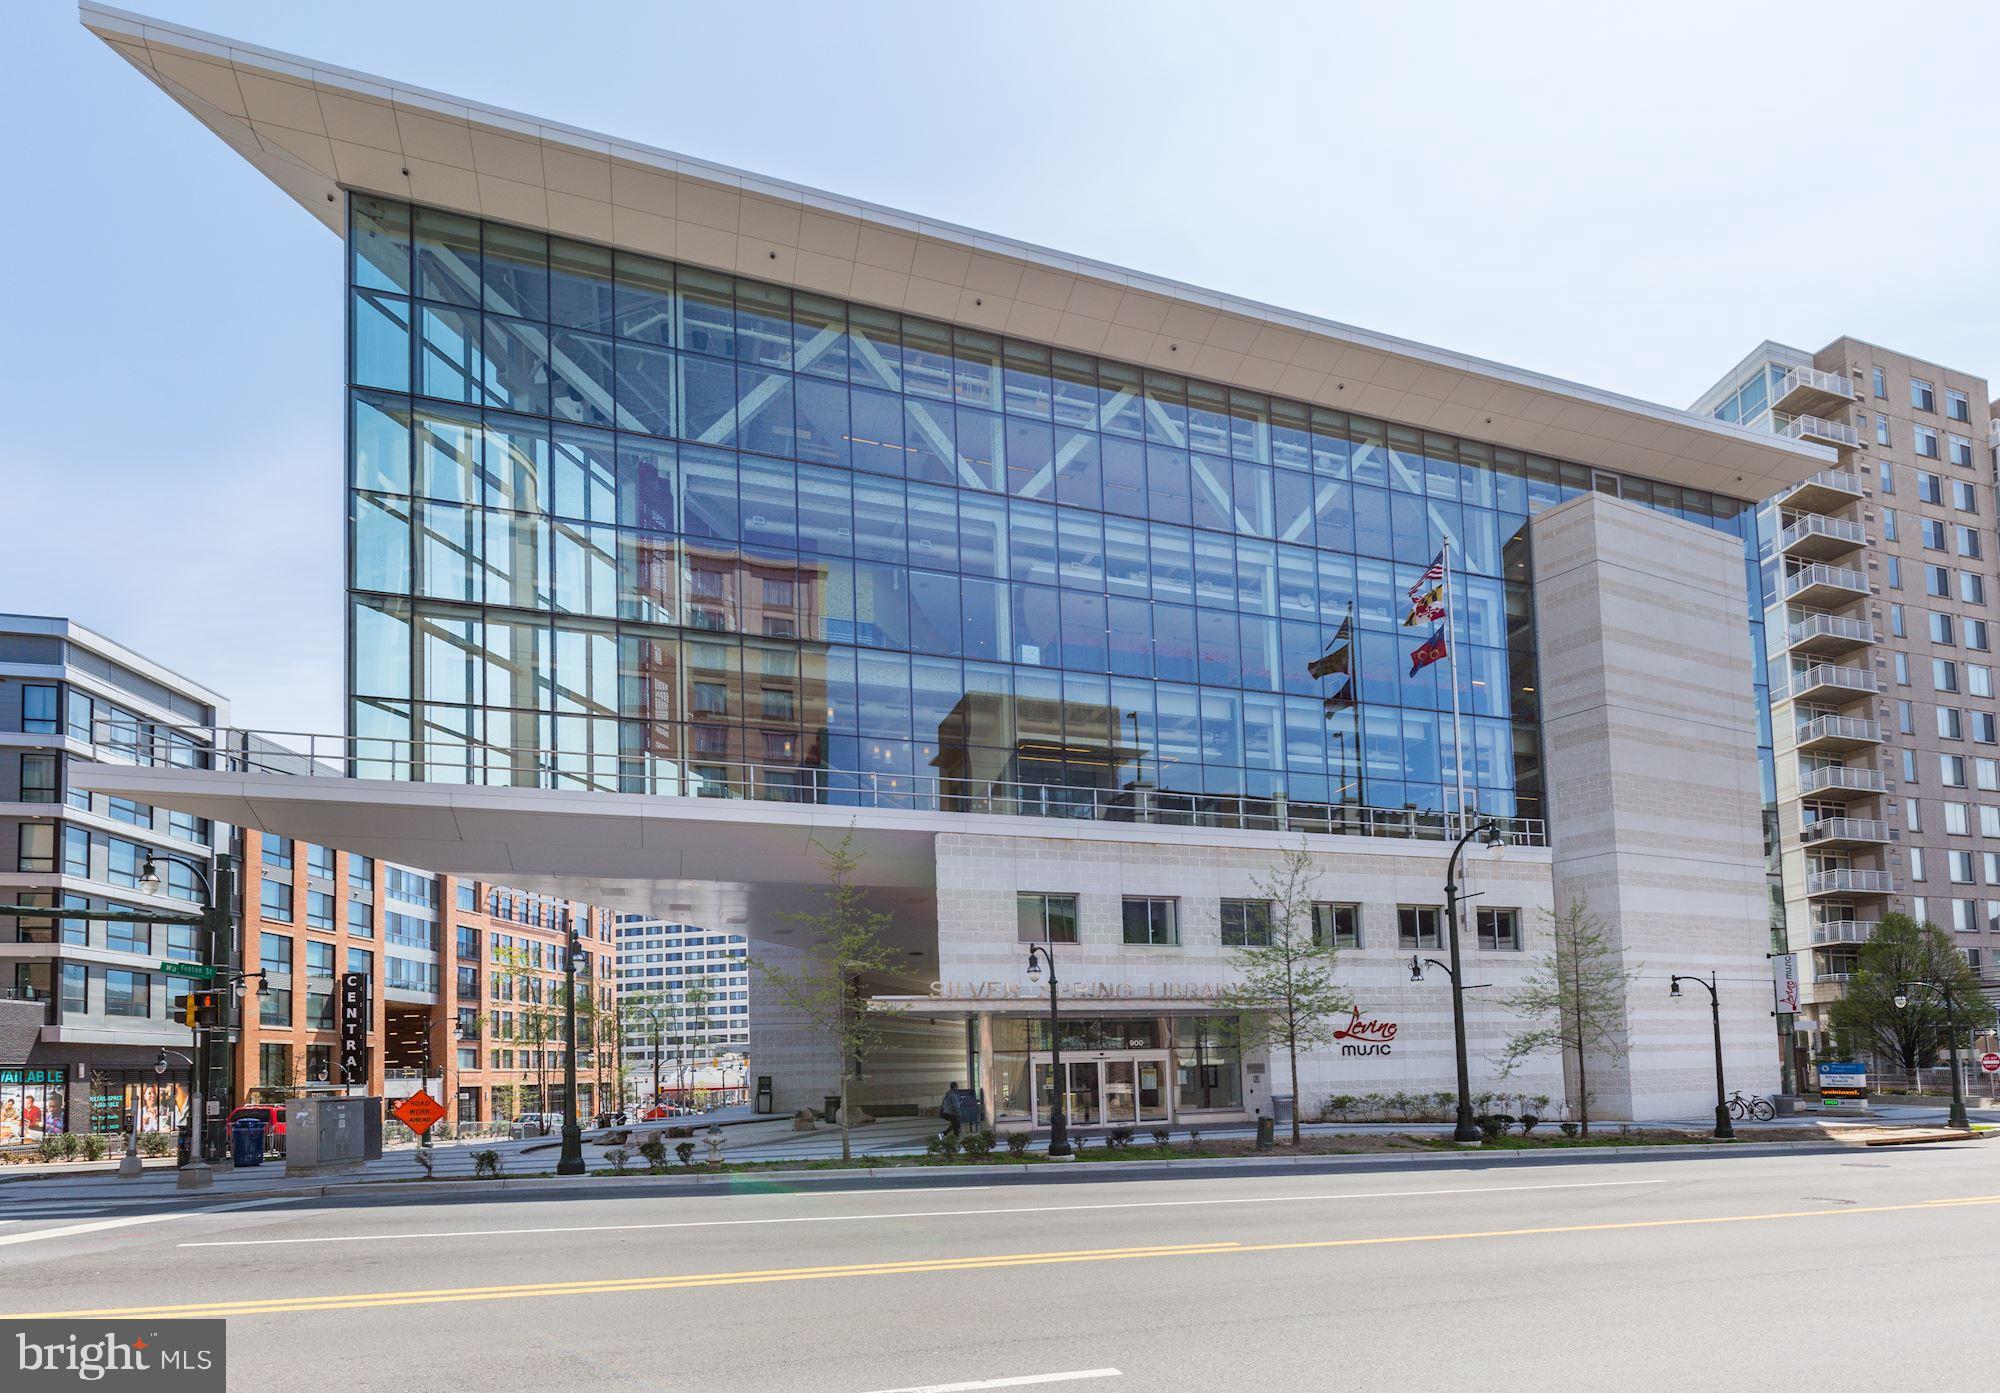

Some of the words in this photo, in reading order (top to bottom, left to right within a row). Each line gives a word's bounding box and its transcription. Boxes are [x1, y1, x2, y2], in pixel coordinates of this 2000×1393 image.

[180, 965, 203, 974] Fenton
[205, 967, 213, 976] St
[928, 981, 1020, 999] SILVER
[1039, 981, 1133, 999] SPRING
[1149, 981, 1246, 999] LIBRARY
[346, 976, 357, 1082] CENTRAL
[1333, 1005, 1397, 1042] Levine
